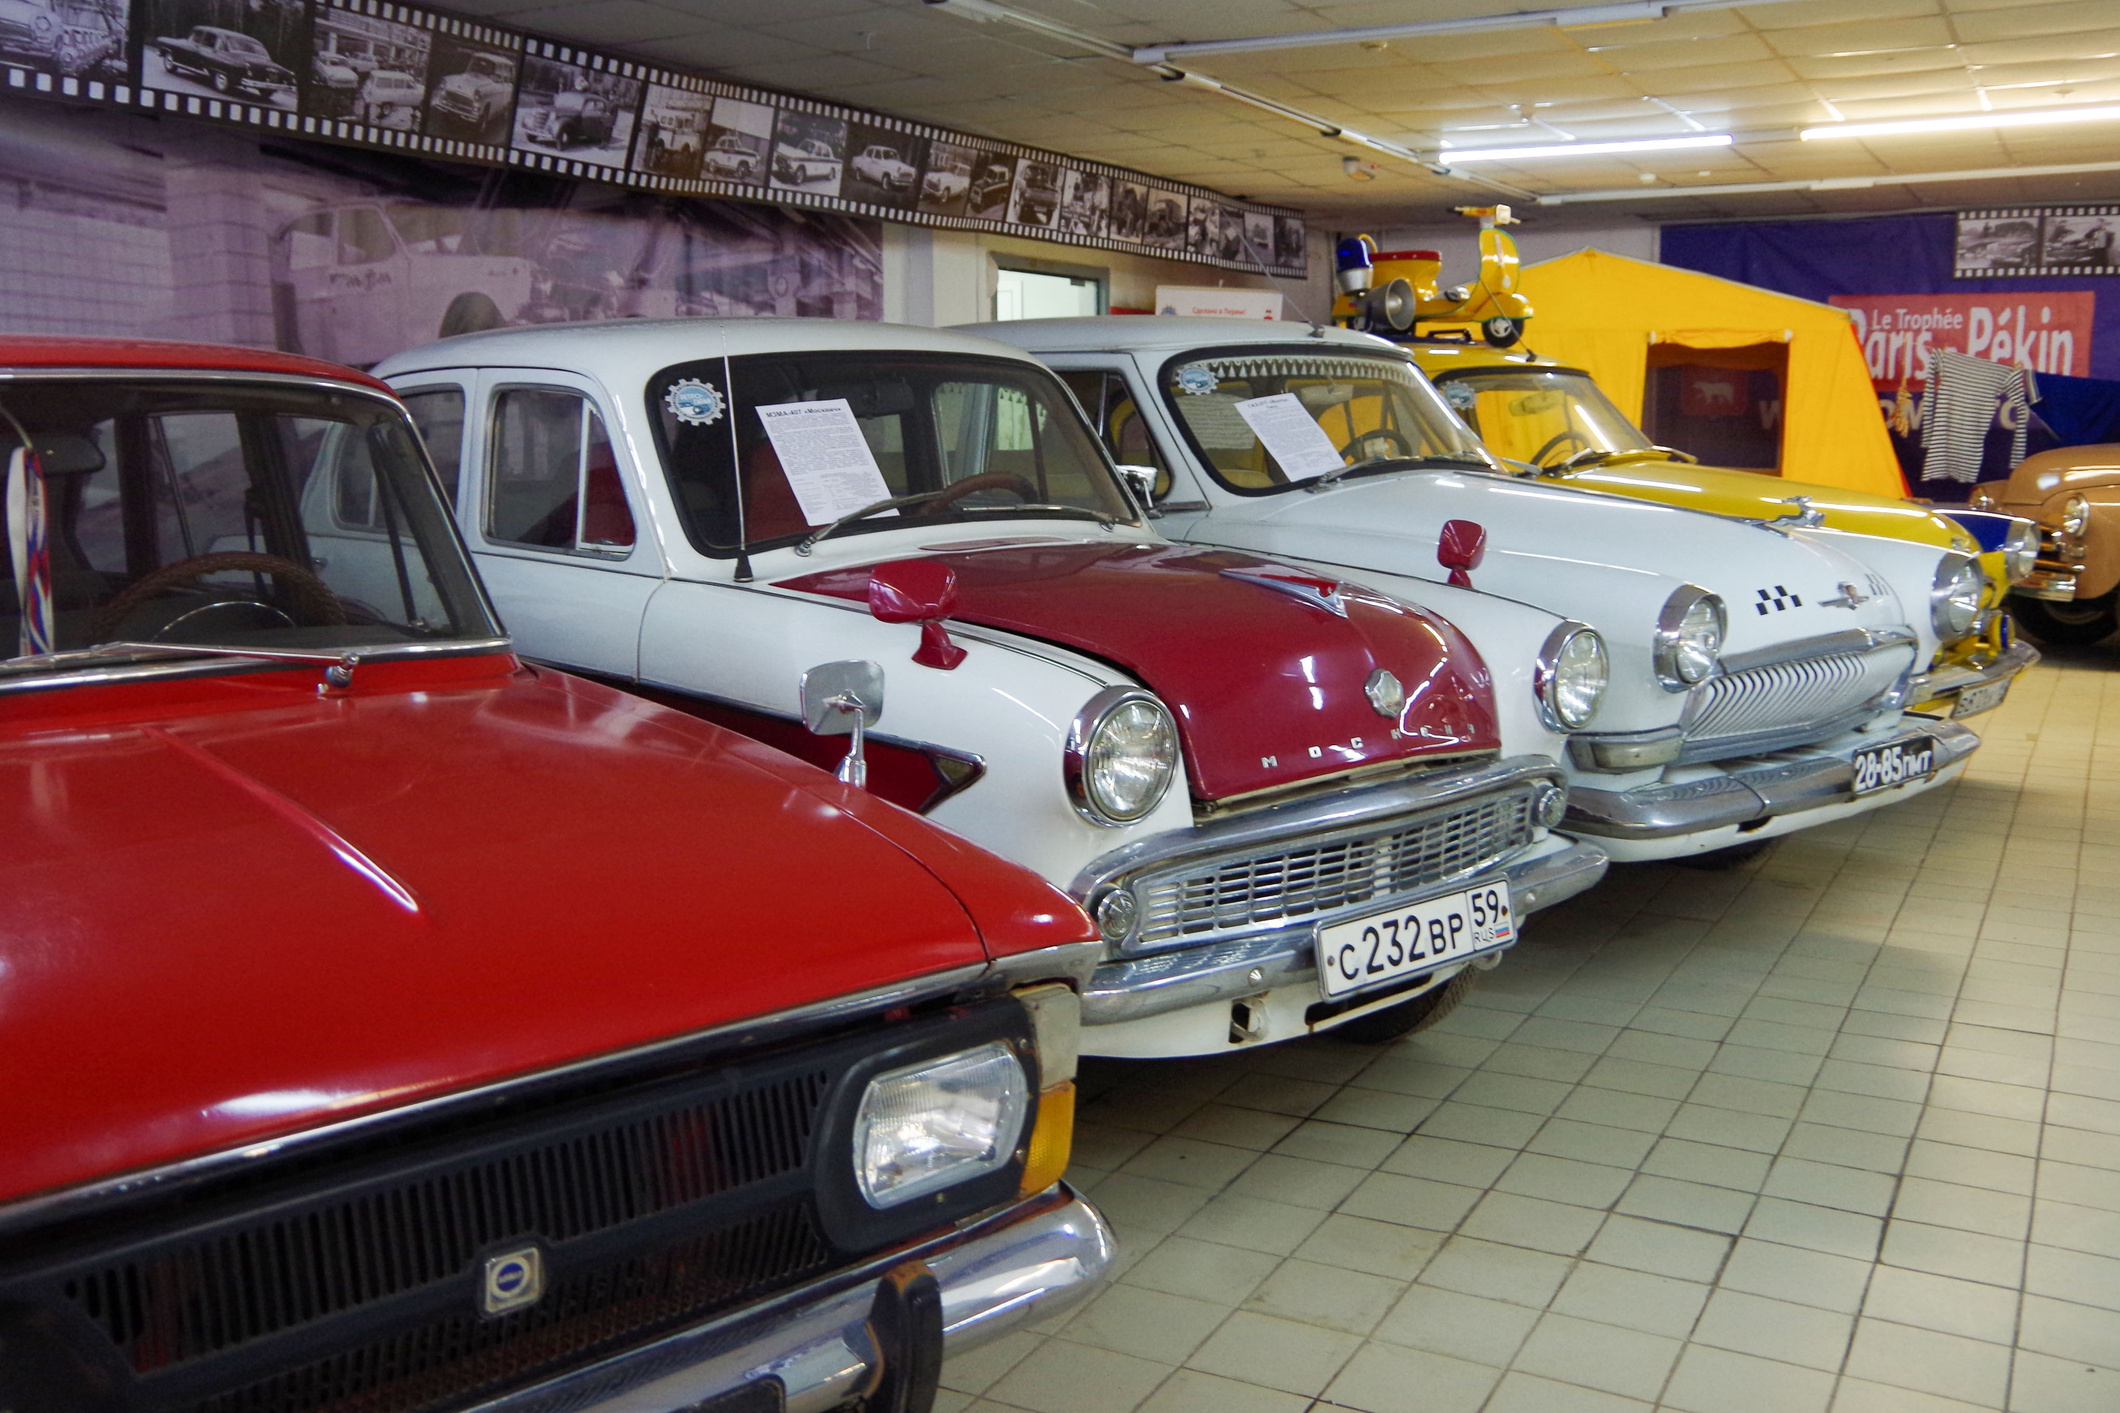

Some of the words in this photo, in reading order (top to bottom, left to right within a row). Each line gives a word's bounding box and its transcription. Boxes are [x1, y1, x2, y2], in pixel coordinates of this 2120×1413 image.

[1872, 308, 1891, 330] Le
[1896, 307, 1963, 332] Trophée
[1968, 305, 2074, 376] Pékin
[1471, 889, 1499, 927] 59
[1474, 927, 1495, 944] RUS
